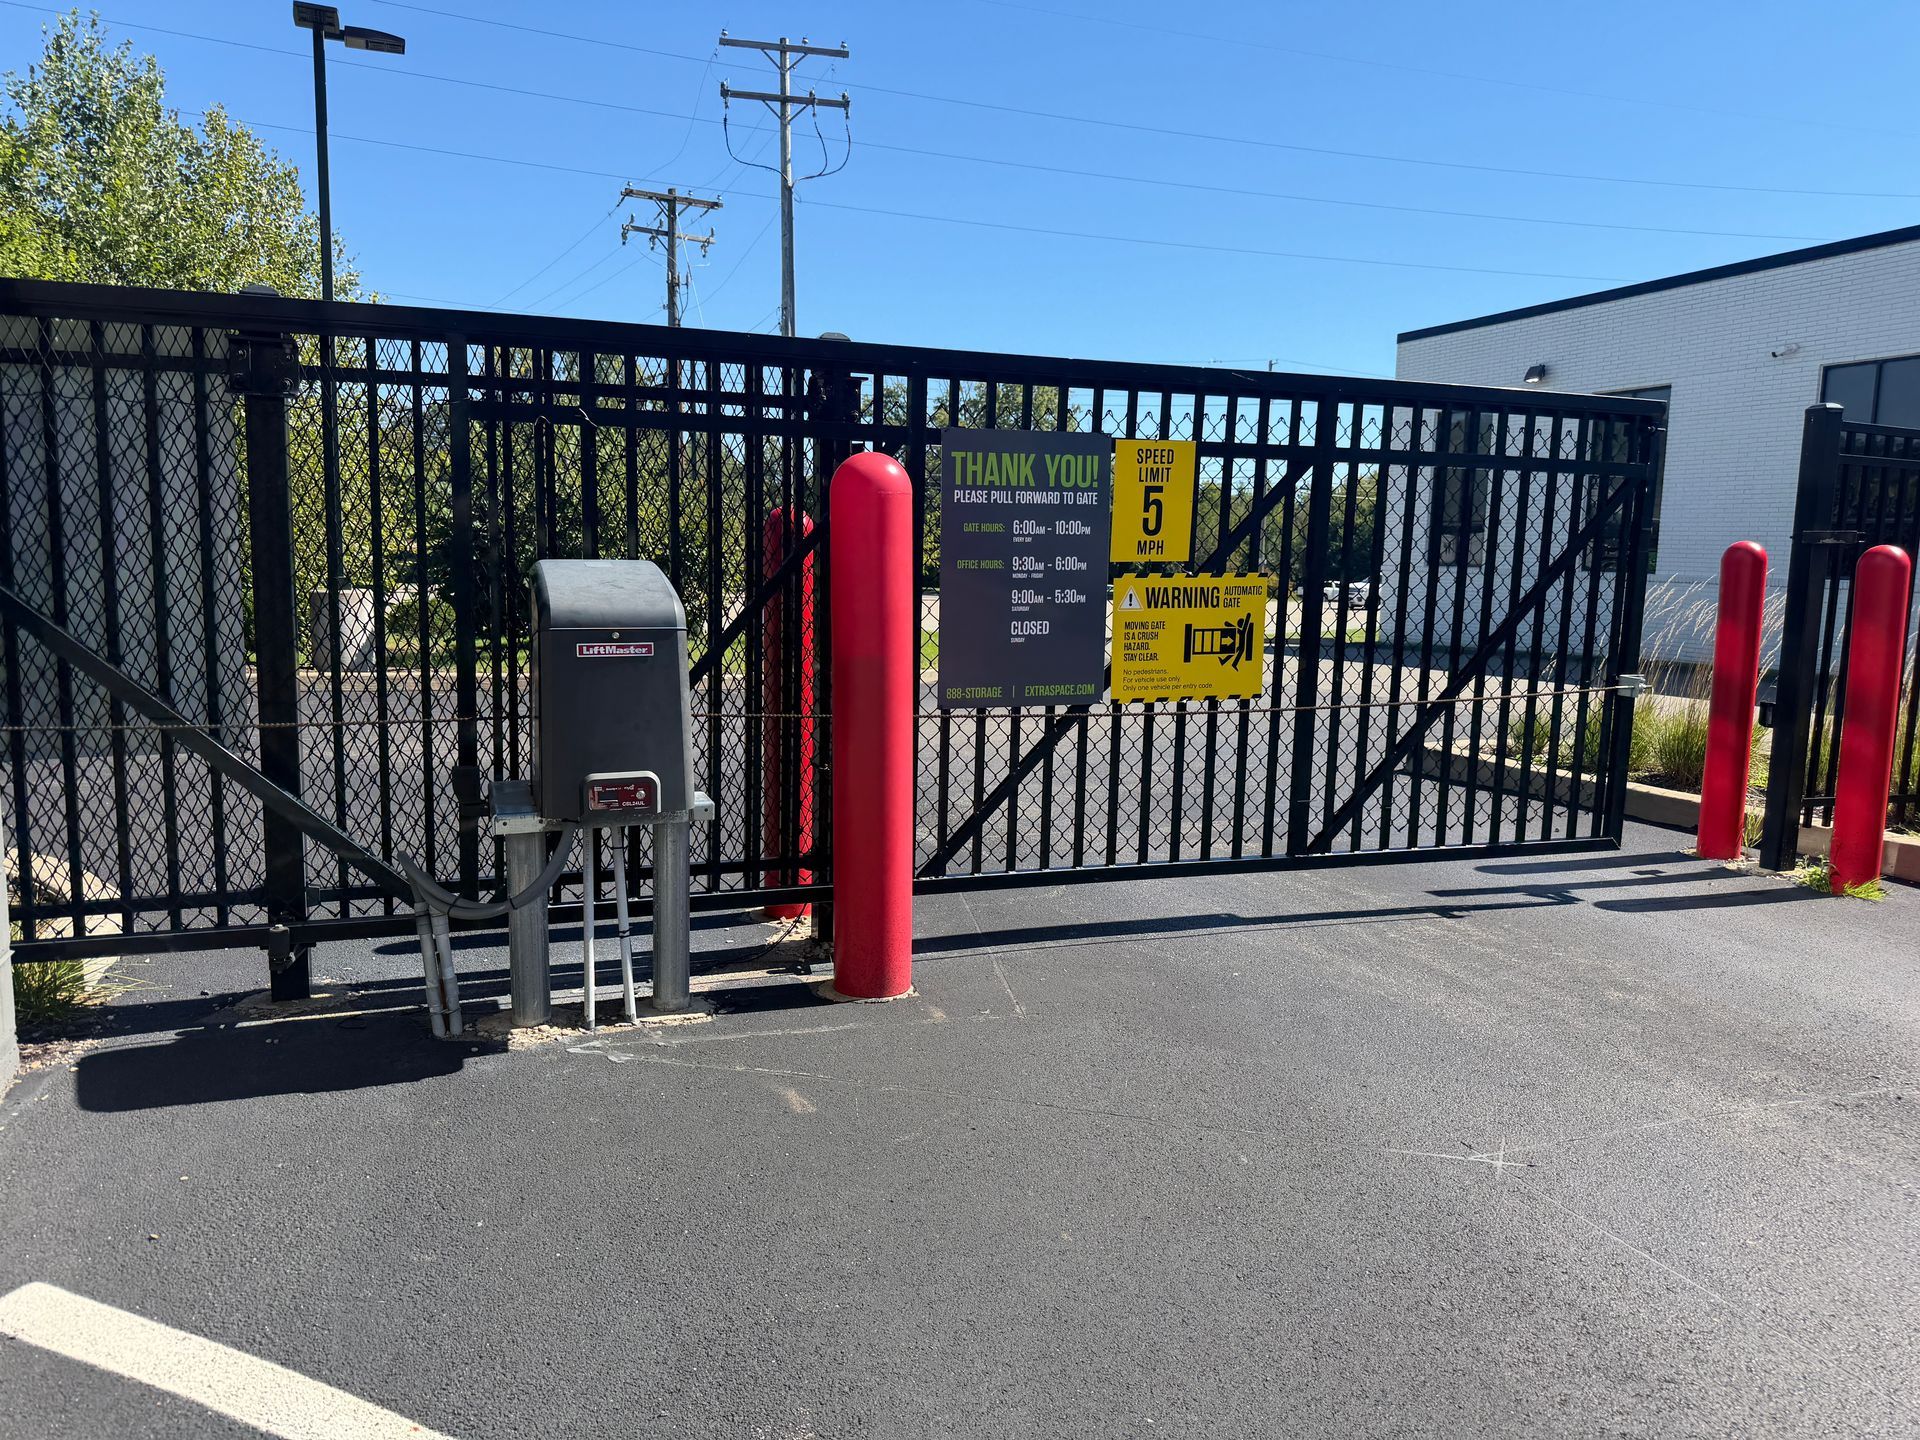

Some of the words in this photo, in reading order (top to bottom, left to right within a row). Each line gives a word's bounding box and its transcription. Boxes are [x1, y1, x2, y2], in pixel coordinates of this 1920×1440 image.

[1137, 449, 1174, 464] SPEED
[951, 452, 1036, 487] THANK
[1045, 454, 1099, 488] YOU!
[1139, 467, 1171, 482] LIMIT
[954, 490, 988, 503] PLEASE
[991, 490, 1013, 504] PULL
[1016, 491, 1060, 504] FORWARD
[1063, 492, 1074, 504] TO
[1077, 492, 1098, 505] GATE
[1142, 485, 1164, 536] 5
[963, 523, 979, 532] GATE
[981, 523, 1005, 532] HOURS:
[1013, 520, 1045, 535] 6:00AM
[1055, 520, 1091, 535] 10:00PM
[1137, 540, 1164, 555] MPH
[957, 560, 979, 569] OFFICE
[980, 560, 1005, 569] HOURS:
[1012, 556, 1044, 571] 9:30AM
[1055, 556, 1087, 571] 6:00PM
[1011, 589, 1044, 604] 9:00AM
[1055, 589, 1086, 603] 5:30PM
[1224, 586, 1263, 595] AUTOMATIC
[1145, 587, 1220, 609] WARNING
[1223, 598, 1241, 608] GATE
[1010, 621, 1050, 635] CLOSED
[1124, 621, 1149, 630] MOVING
[1151, 621, 1166, 630] GATE
[1124, 632, 1131, 640] IS
[1131, 632, 1136, 640] A
[1137, 631, 1158, 640] CRUSH
[583, 646, 648, 655] LiftMaster
[1124, 642, 1150, 651] HAZARD.
[1123, 653, 1137, 662] STAY
[1138, 652, 1159, 661] CLEAR.
[1133, 668, 1168, 676] pedestrians.
[1168, 676, 1180, 684] only
[946, 686, 1002, 699] 888-STORAGE
[1024, 684, 1095, 697] EXTRASPACE.COM
[1123, 684, 1136, 692] Only
[1171, 684, 1181, 692] per
